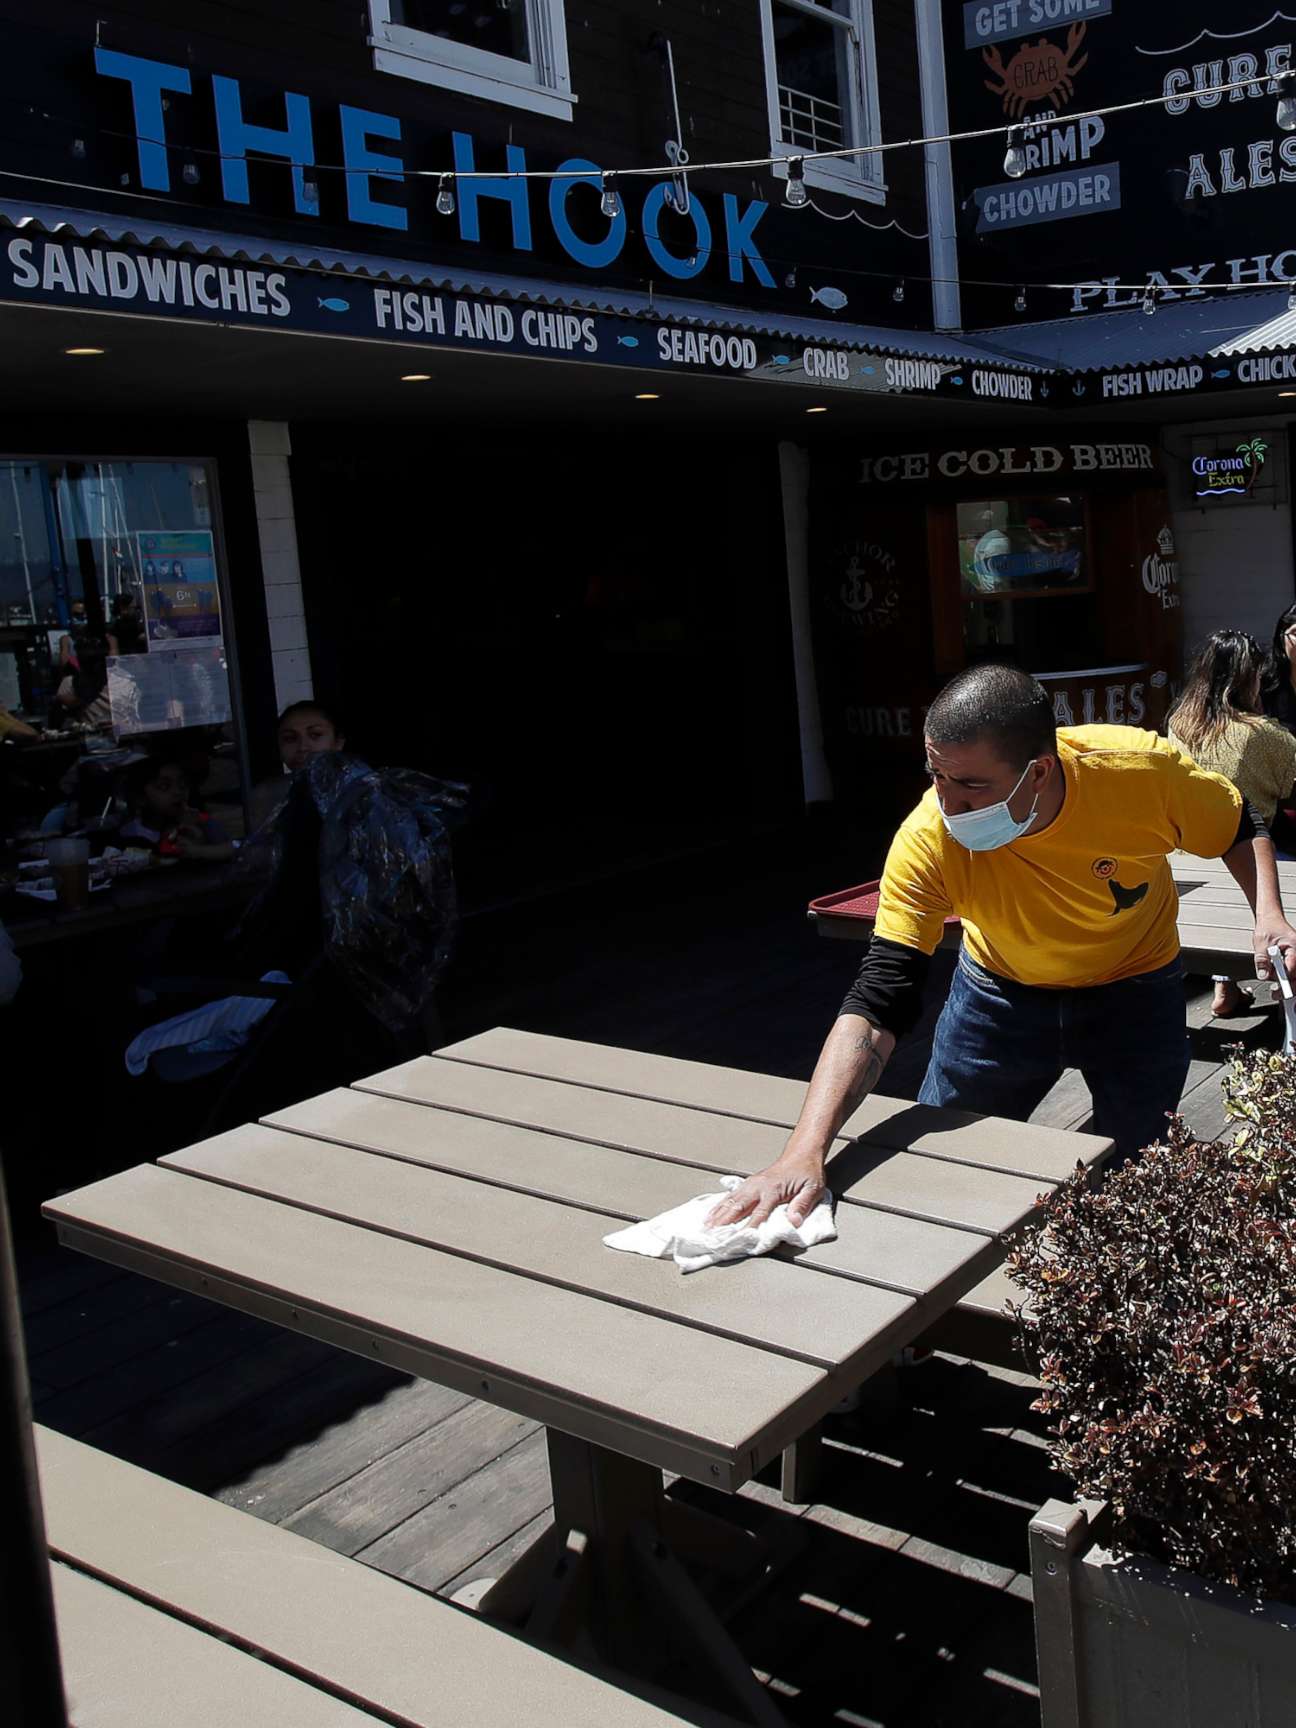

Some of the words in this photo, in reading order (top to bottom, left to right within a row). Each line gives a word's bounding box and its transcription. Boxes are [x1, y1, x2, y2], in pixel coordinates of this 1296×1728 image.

[975, 2, 1021, 36] GET
[1013, 56, 1060, 90] CRAB
[1025, 115, 1106, 171] RIMP
[94, 46, 409, 231] THE
[452, 130, 777, 289] HOOK
[983, 174, 1111, 223] CHOWDER
[7, 238, 292, 317] SANDWICHES
[1069, 262, 1216, 312] PLAY
[374, 288, 446, 334] FISH
[454, 299, 514, 344] AND
[521, 310, 599, 353] CHIPS
[656, 326, 757, 370] SEAFOOD
[803, 346, 850, 380] CRAB
[885, 358, 942, 391] SHRIMP
[971, 369, 1033, 401] CHOWDER
[1102, 370, 1142, 397] FISH
[1145, 364, 1204, 393] WRAP
[857, 452, 931, 484] ICE
[937, 446, 1066, 478] COLD
[1068, 442, 1154, 472] BEER
[1191, 455, 1245, 477] Corona
[1207, 472, 1245, 488] Extra
[844, 703, 913, 738] CURE
[1053, 682, 1147, 727] ALES
